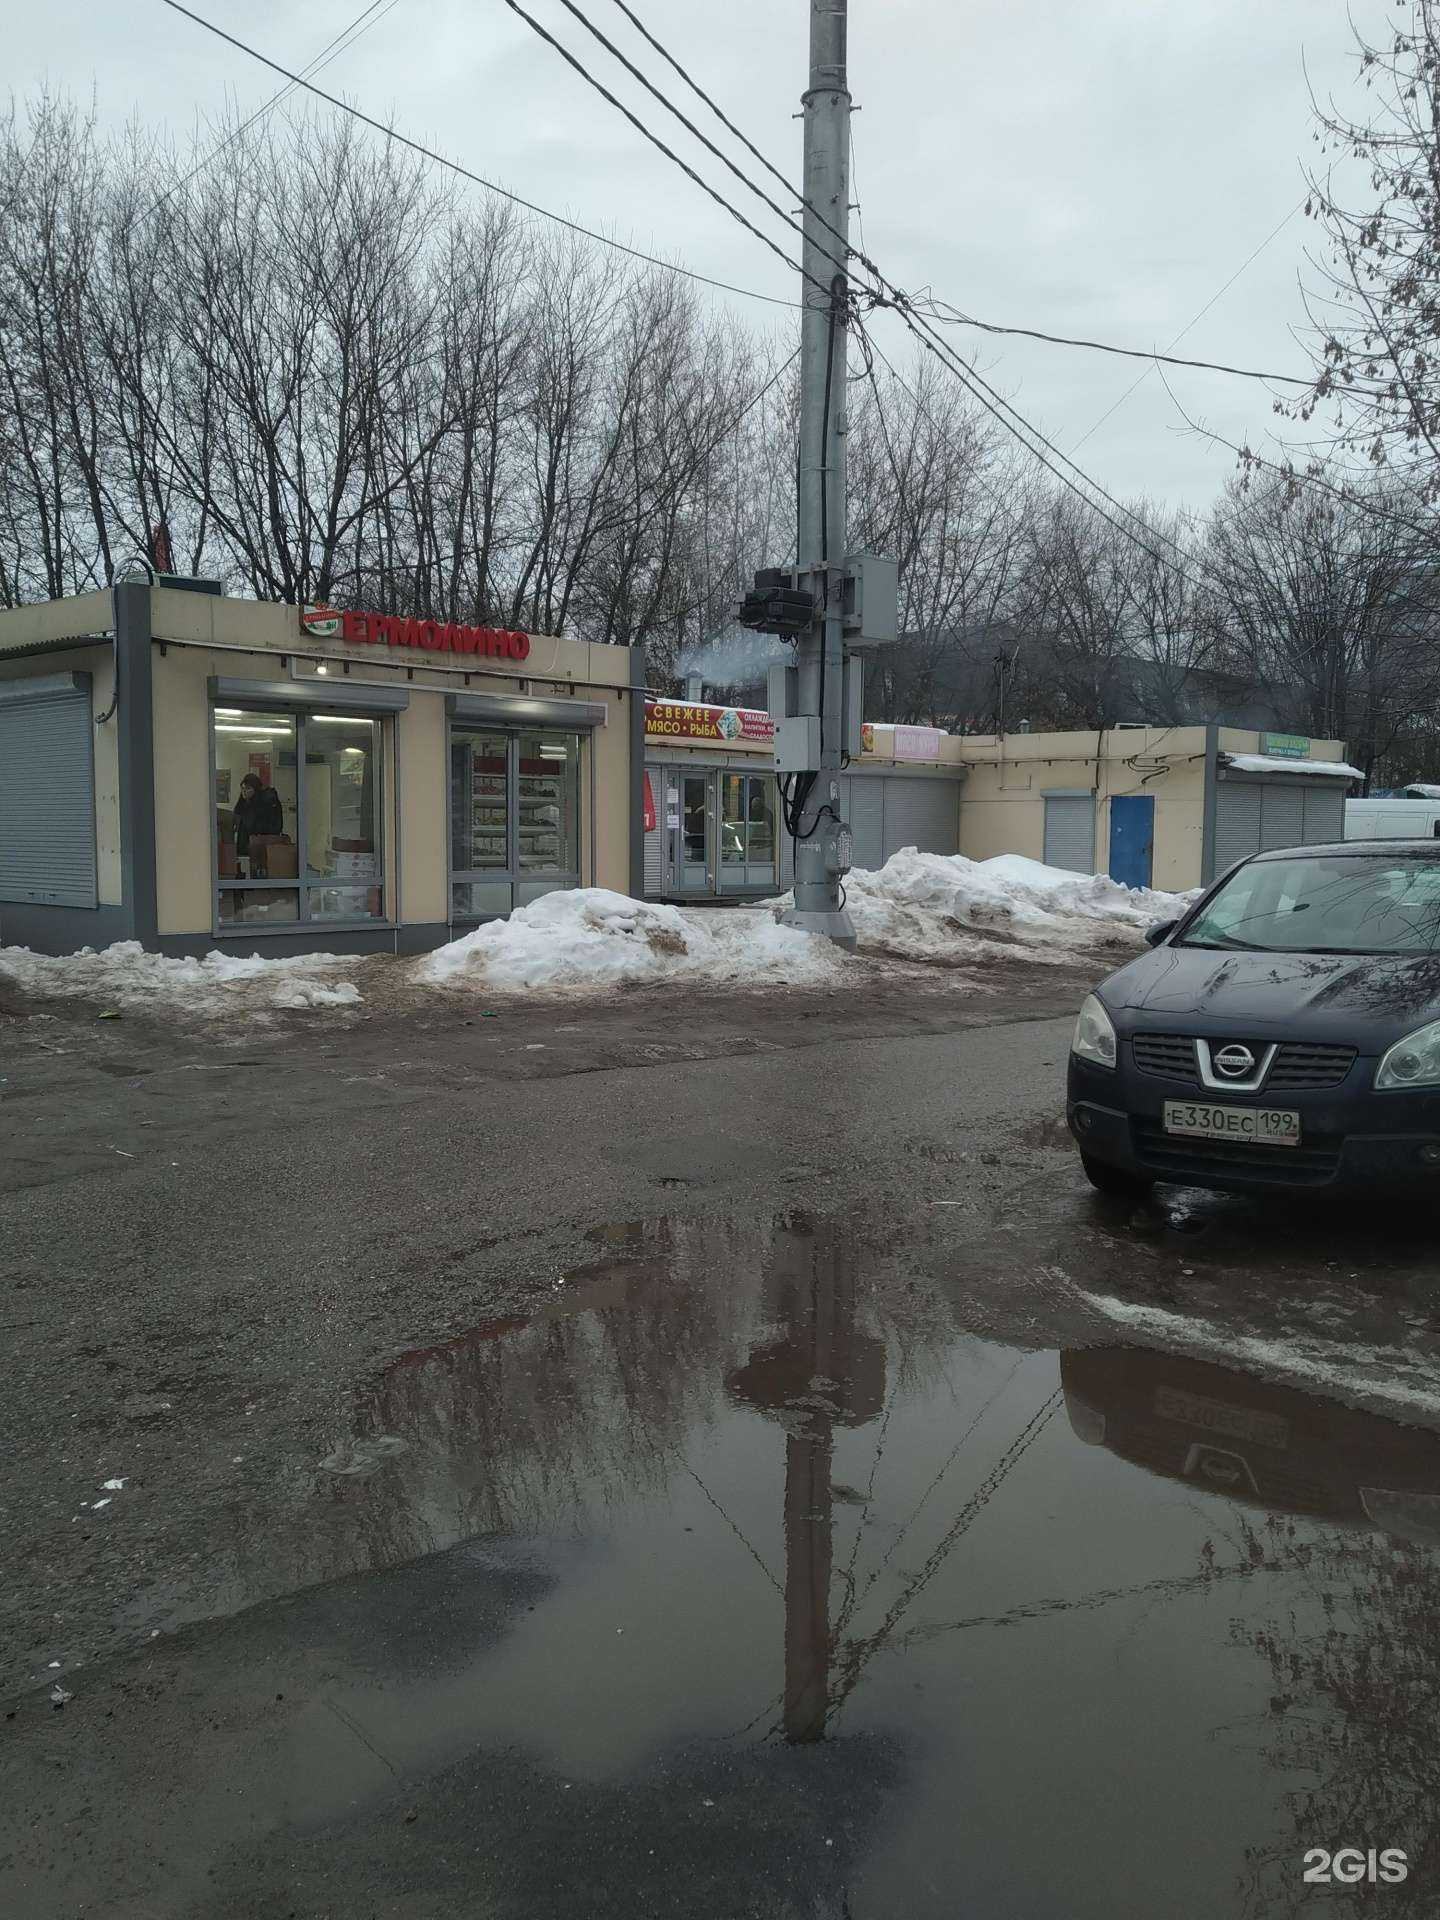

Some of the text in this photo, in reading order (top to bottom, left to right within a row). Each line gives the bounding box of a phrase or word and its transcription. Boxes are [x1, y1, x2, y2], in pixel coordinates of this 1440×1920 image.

[343, 610, 530, 661] ЕРМОЛИНО
[653, 705, 710, 722] СВЕЖЕЕ
[647, 720, 717, 737] МЯСО РЫБА
